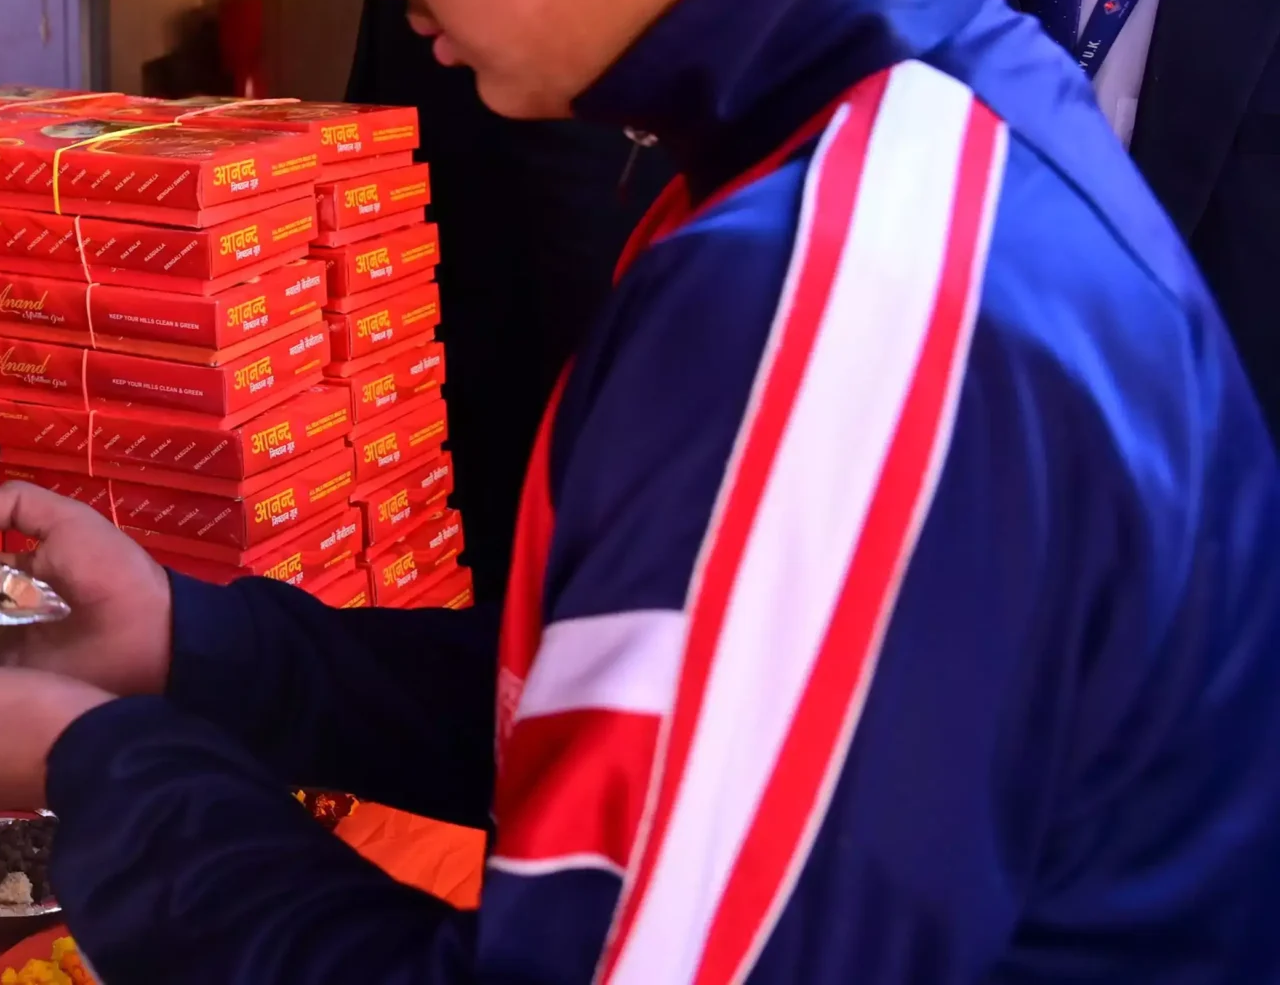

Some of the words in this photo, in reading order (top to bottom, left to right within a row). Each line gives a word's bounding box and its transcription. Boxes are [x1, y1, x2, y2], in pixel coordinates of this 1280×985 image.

[321, 123, 360, 145] आनन्द
[214, 159, 257, 186] आनन्द
[346, 184, 378, 208] आनन्द
[220, 225, 259, 255] आनन्द
[163, 253, 181, 270] BENGALI
[356, 247, 389, 273] आनन्द
[109, 313, 122, 321] KEEP
[123, 315, 138, 323] YOUR
[139, 316, 154, 324] HILLS
[179, 321, 199, 329] GREEN
[228, 296, 266, 327] आनन्द
[358, 310, 390, 336] आनन्द
[234, 356, 271, 390] आनन्द
[112, 379, 125, 387] KEEP
[127, 380, 143, 388] YOUR
[143, 382, 158, 390] HILLS
[159, 384, 178, 392] CLEAN
[184, 388, 203, 396] GREEN
[252, 421, 292, 454] आनन्द
[255, 488, 295, 522] आनन्द
